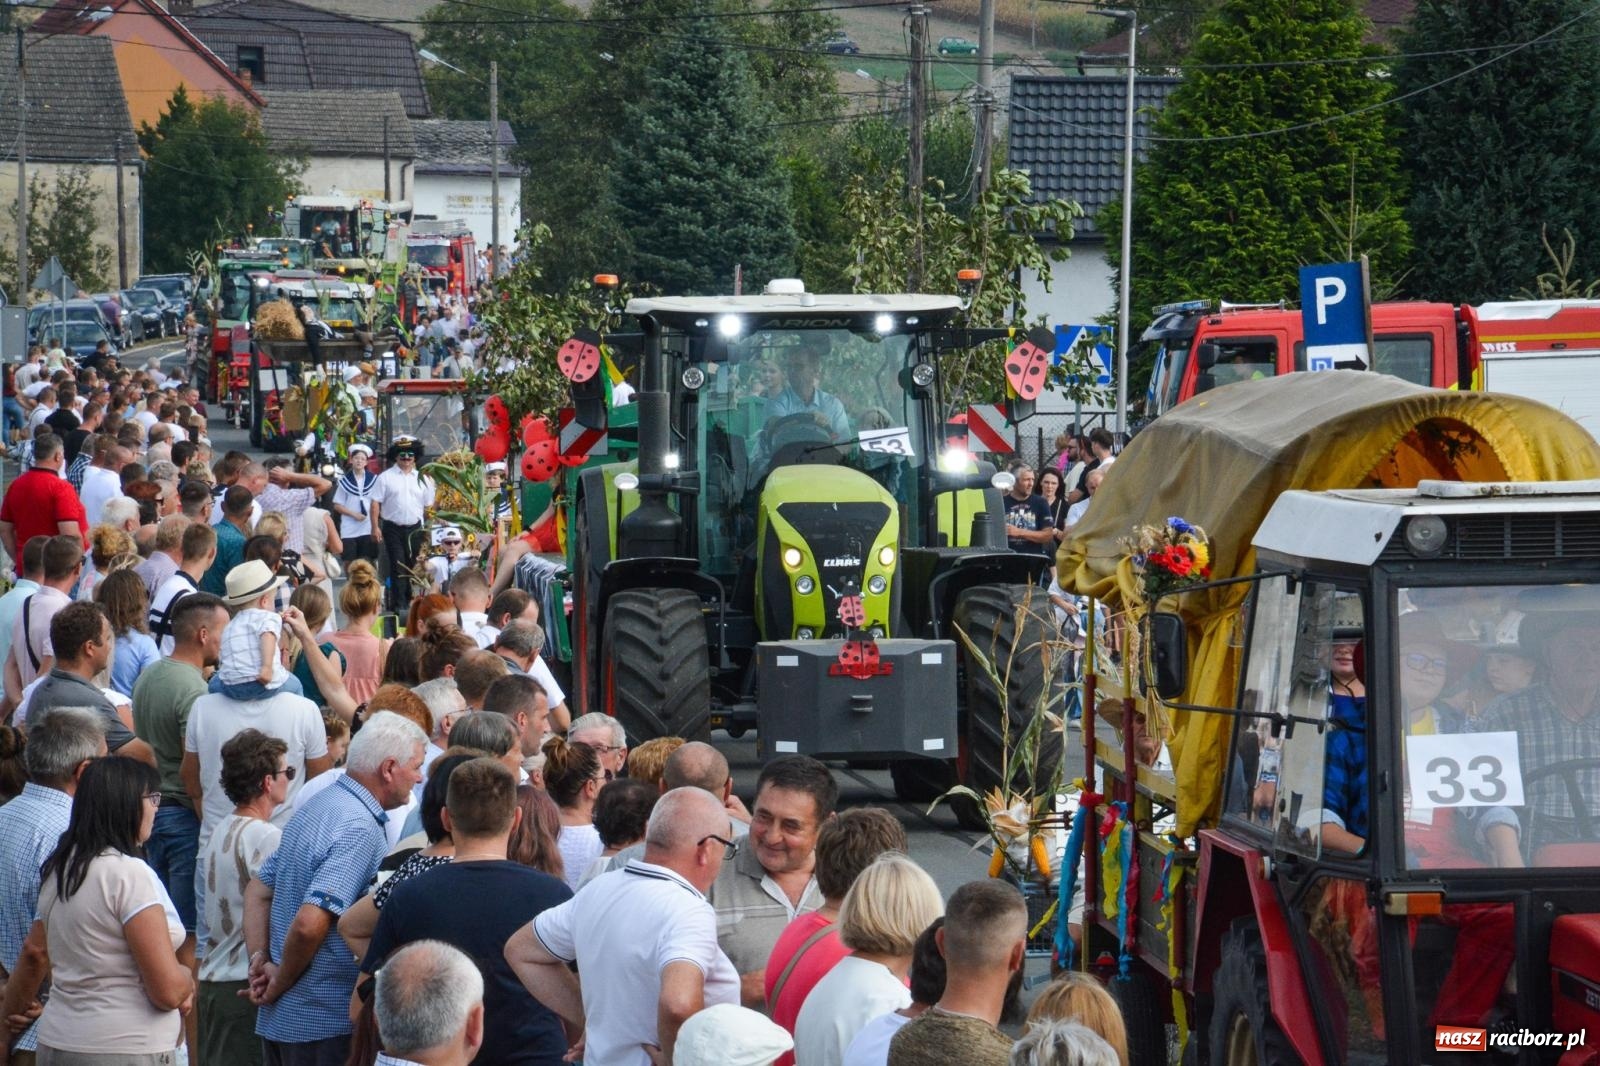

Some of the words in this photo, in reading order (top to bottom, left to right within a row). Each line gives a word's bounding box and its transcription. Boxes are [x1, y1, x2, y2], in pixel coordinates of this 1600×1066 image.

[1315, 276, 1347, 325] P
[762, 318, 851, 329] ARION
[868, 438, 906, 455] 53
[823, 558, 861, 567] CLAAS
[1425, 755, 1507, 804] 33
